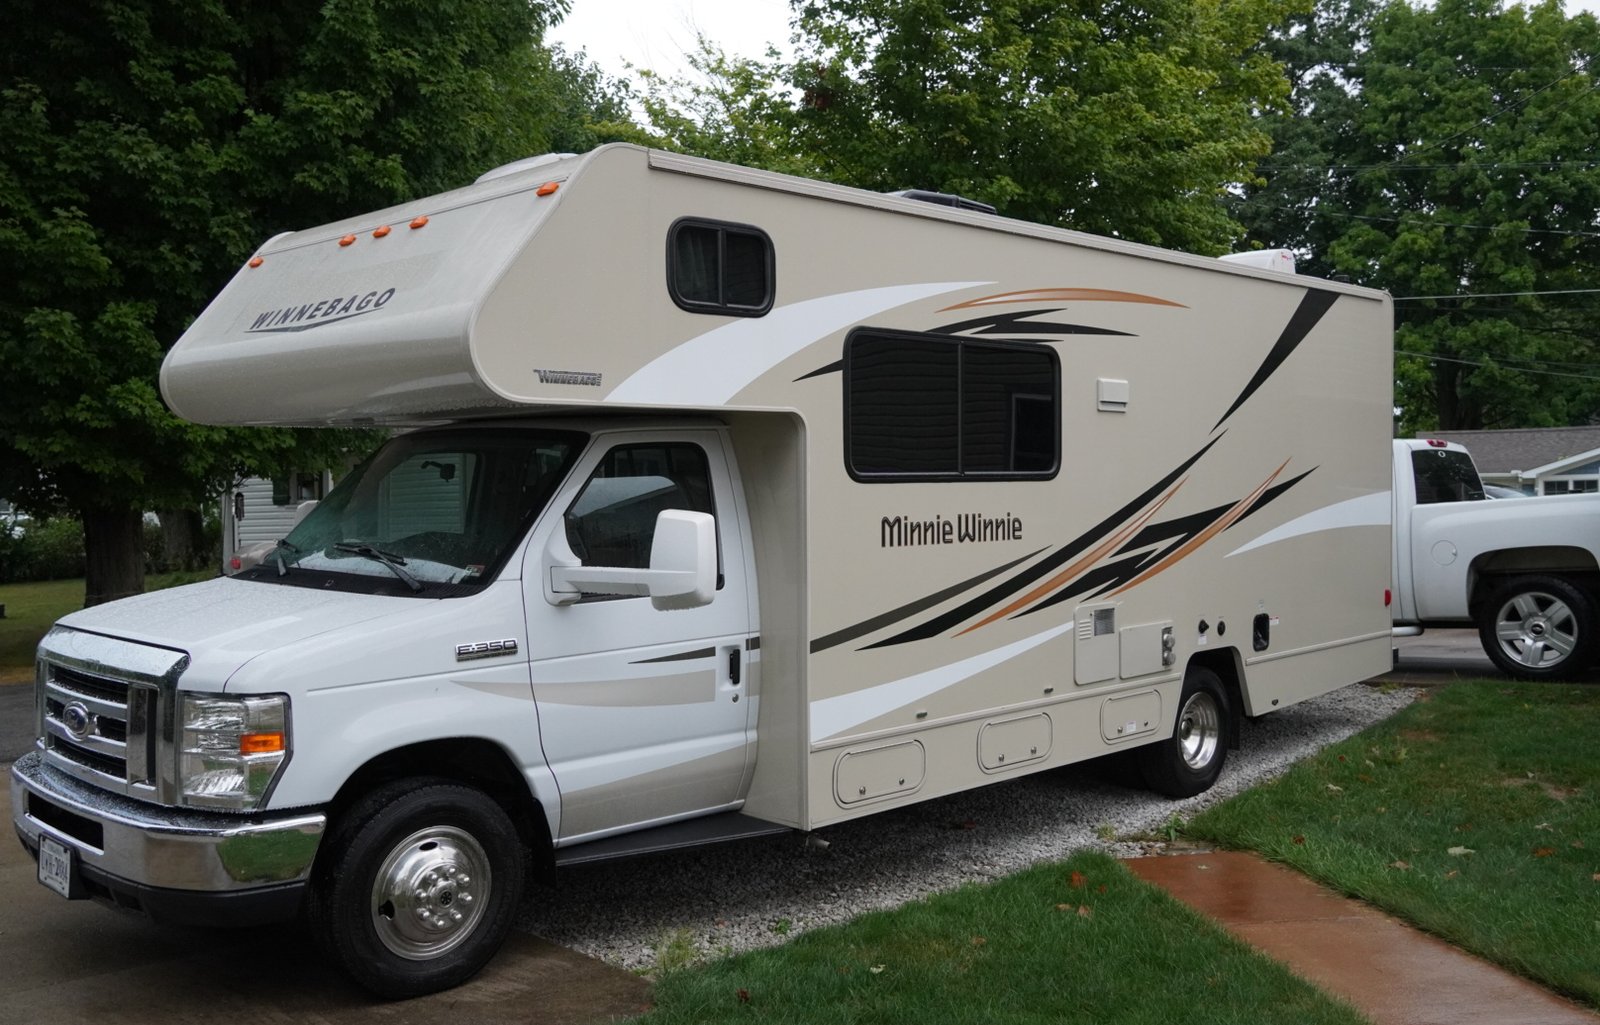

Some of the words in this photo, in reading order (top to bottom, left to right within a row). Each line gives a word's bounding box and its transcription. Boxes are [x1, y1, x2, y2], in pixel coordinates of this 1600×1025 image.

[249, 287, 396, 330] WINNEBAGO
[881, 514, 953, 548] Minnie
[957, 512, 1022, 543] Winnie
